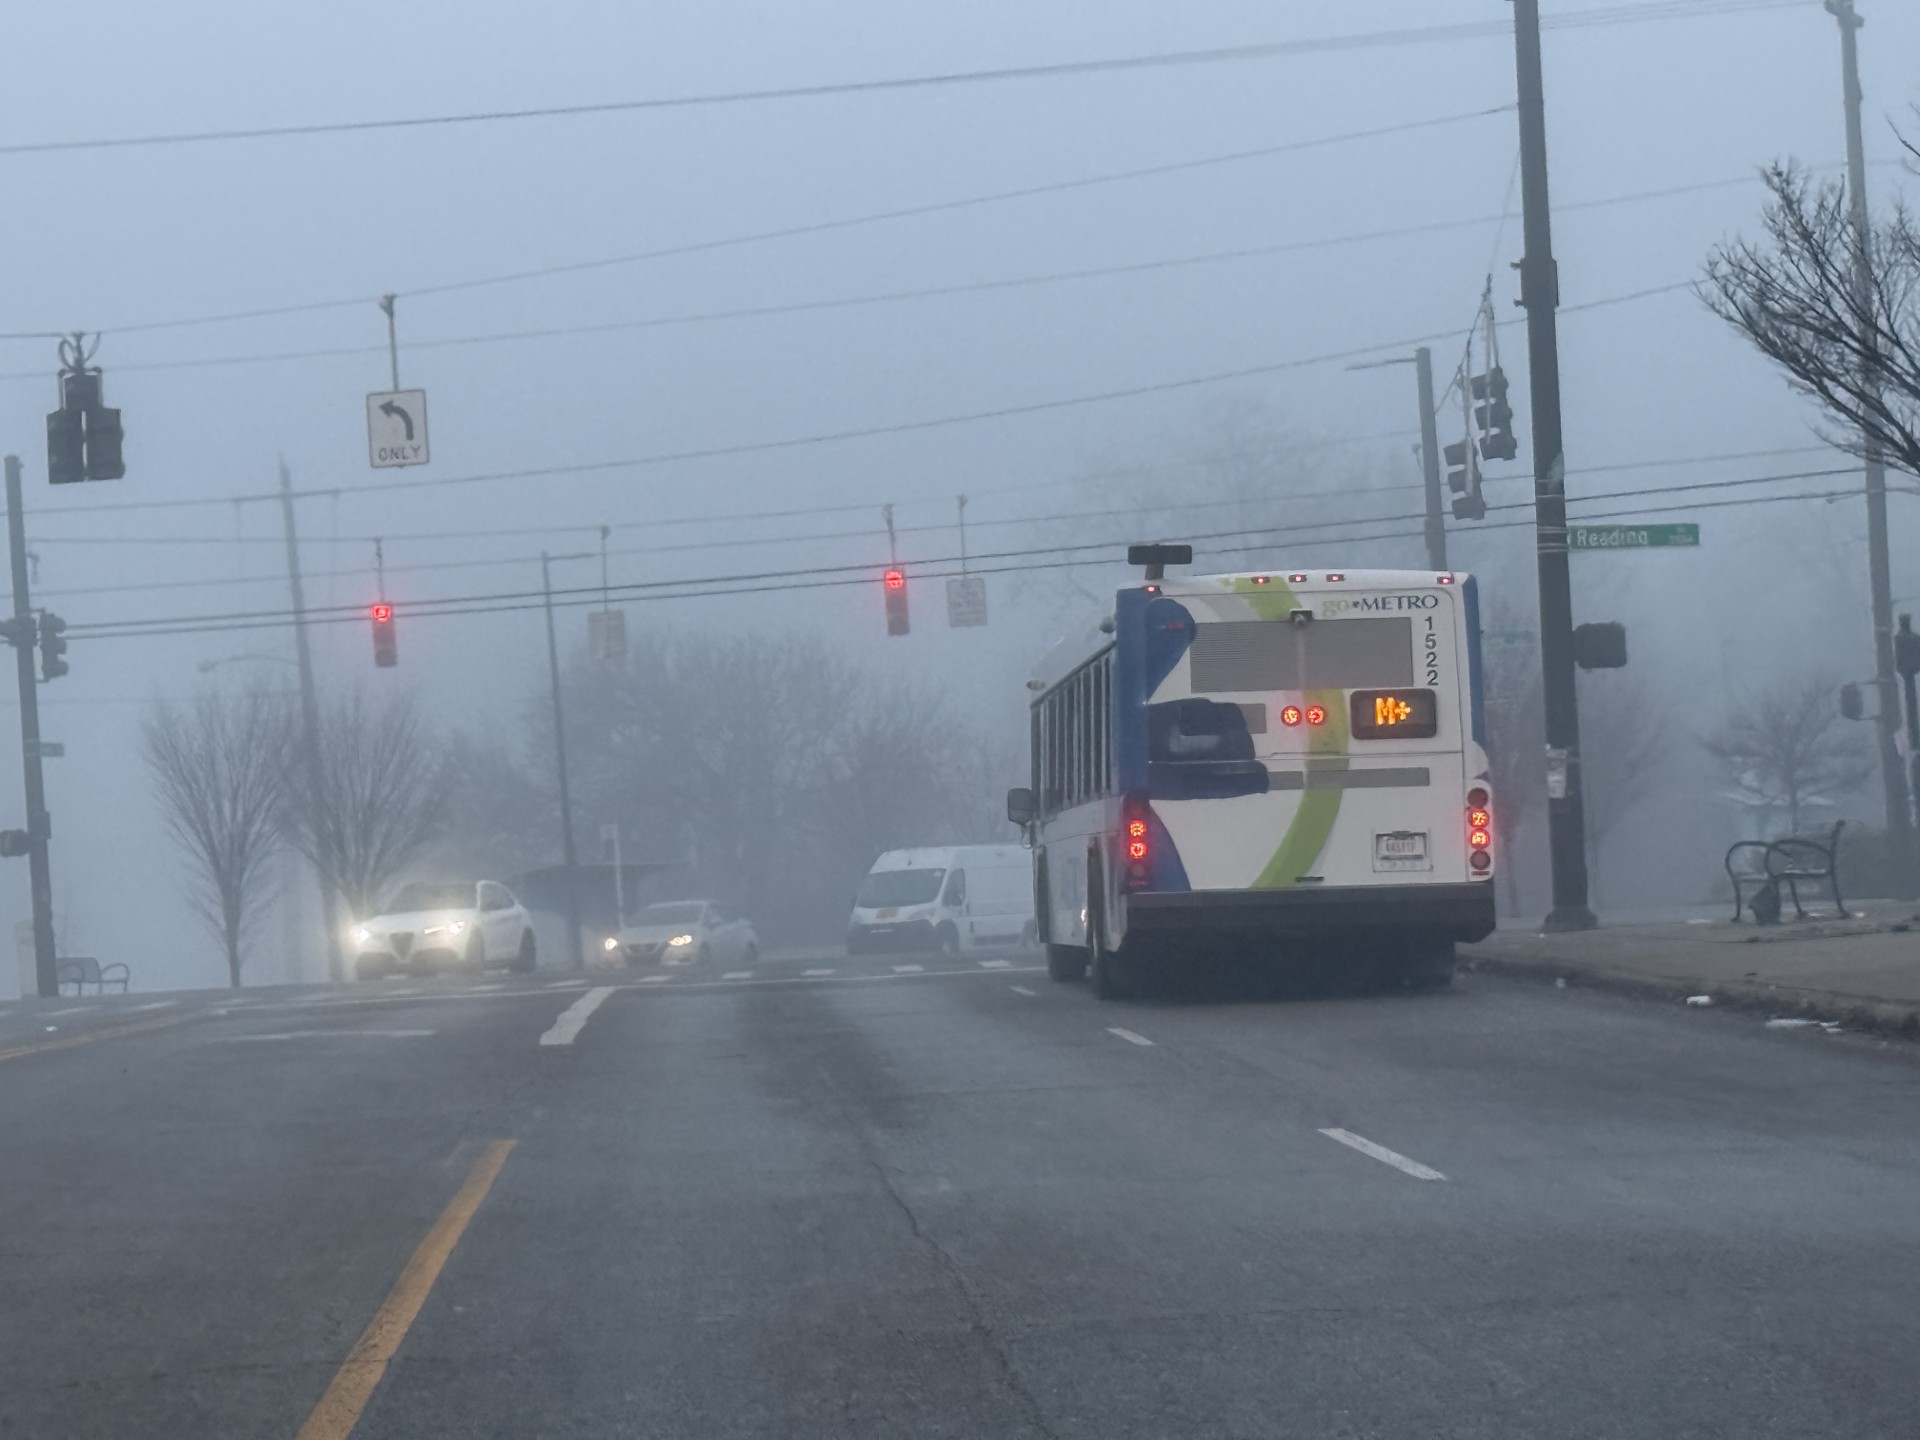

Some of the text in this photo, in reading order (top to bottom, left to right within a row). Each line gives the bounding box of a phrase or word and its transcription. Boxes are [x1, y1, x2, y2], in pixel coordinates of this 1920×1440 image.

[378, 444, 421, 462] ONLY
[1576, 527, 1649, 547] Reading
[1424, 615, 1439, 686] 1522
[1375, 697, 1412, 726] M+
